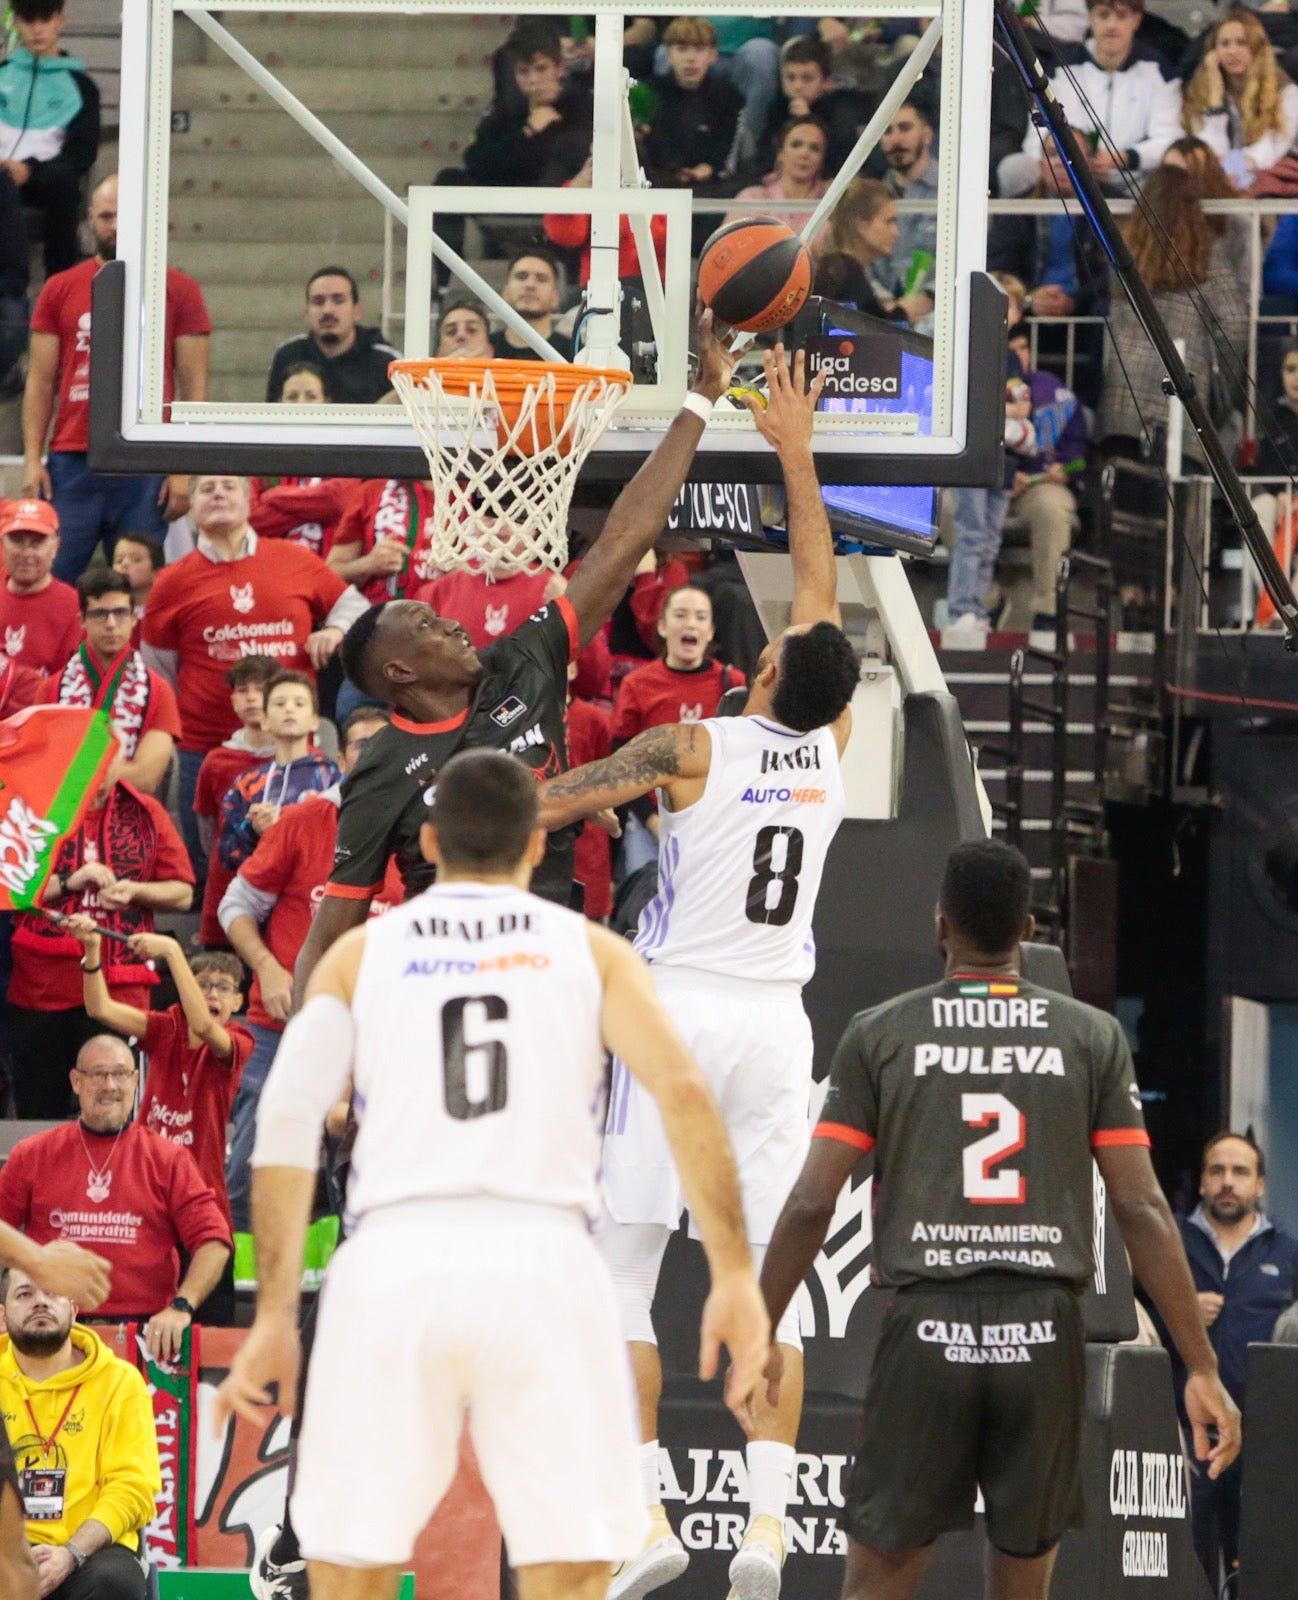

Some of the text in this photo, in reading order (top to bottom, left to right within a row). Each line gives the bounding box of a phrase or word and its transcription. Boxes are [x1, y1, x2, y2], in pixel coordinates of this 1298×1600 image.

[810, 352, 850, 375] liga
[741, 788, 827, 804] AUTOHERO
[745, 825, 804, 926] 8
[405, 914, 541, 942] ABALDE
[402, 953, 550, 977] AUTOHERO
[932, 997, 1050, 1028] MOORE
[441, 995, 508, 1121] 6
[914, 1043, 1065, 1076] PULEVA
[961, 1093, 1026, 1204] 2
[49, 1208, 142, 1228] Comunidades
[911, 1221, 1063, 1243] AYUNTAMIENTO
[925, 1248, 1056, 1268] DE GRANADA
[917, 1319, 1057, 1346] CAJA RURAL
[944, 1346, 1032, 1363] GRANADA
[658, 1447, 750, 1505] AJA
[1109, 1449, 1186, 1520] CAJA RURAL
[1122, 1530, 1168, 1577] GRANADA
